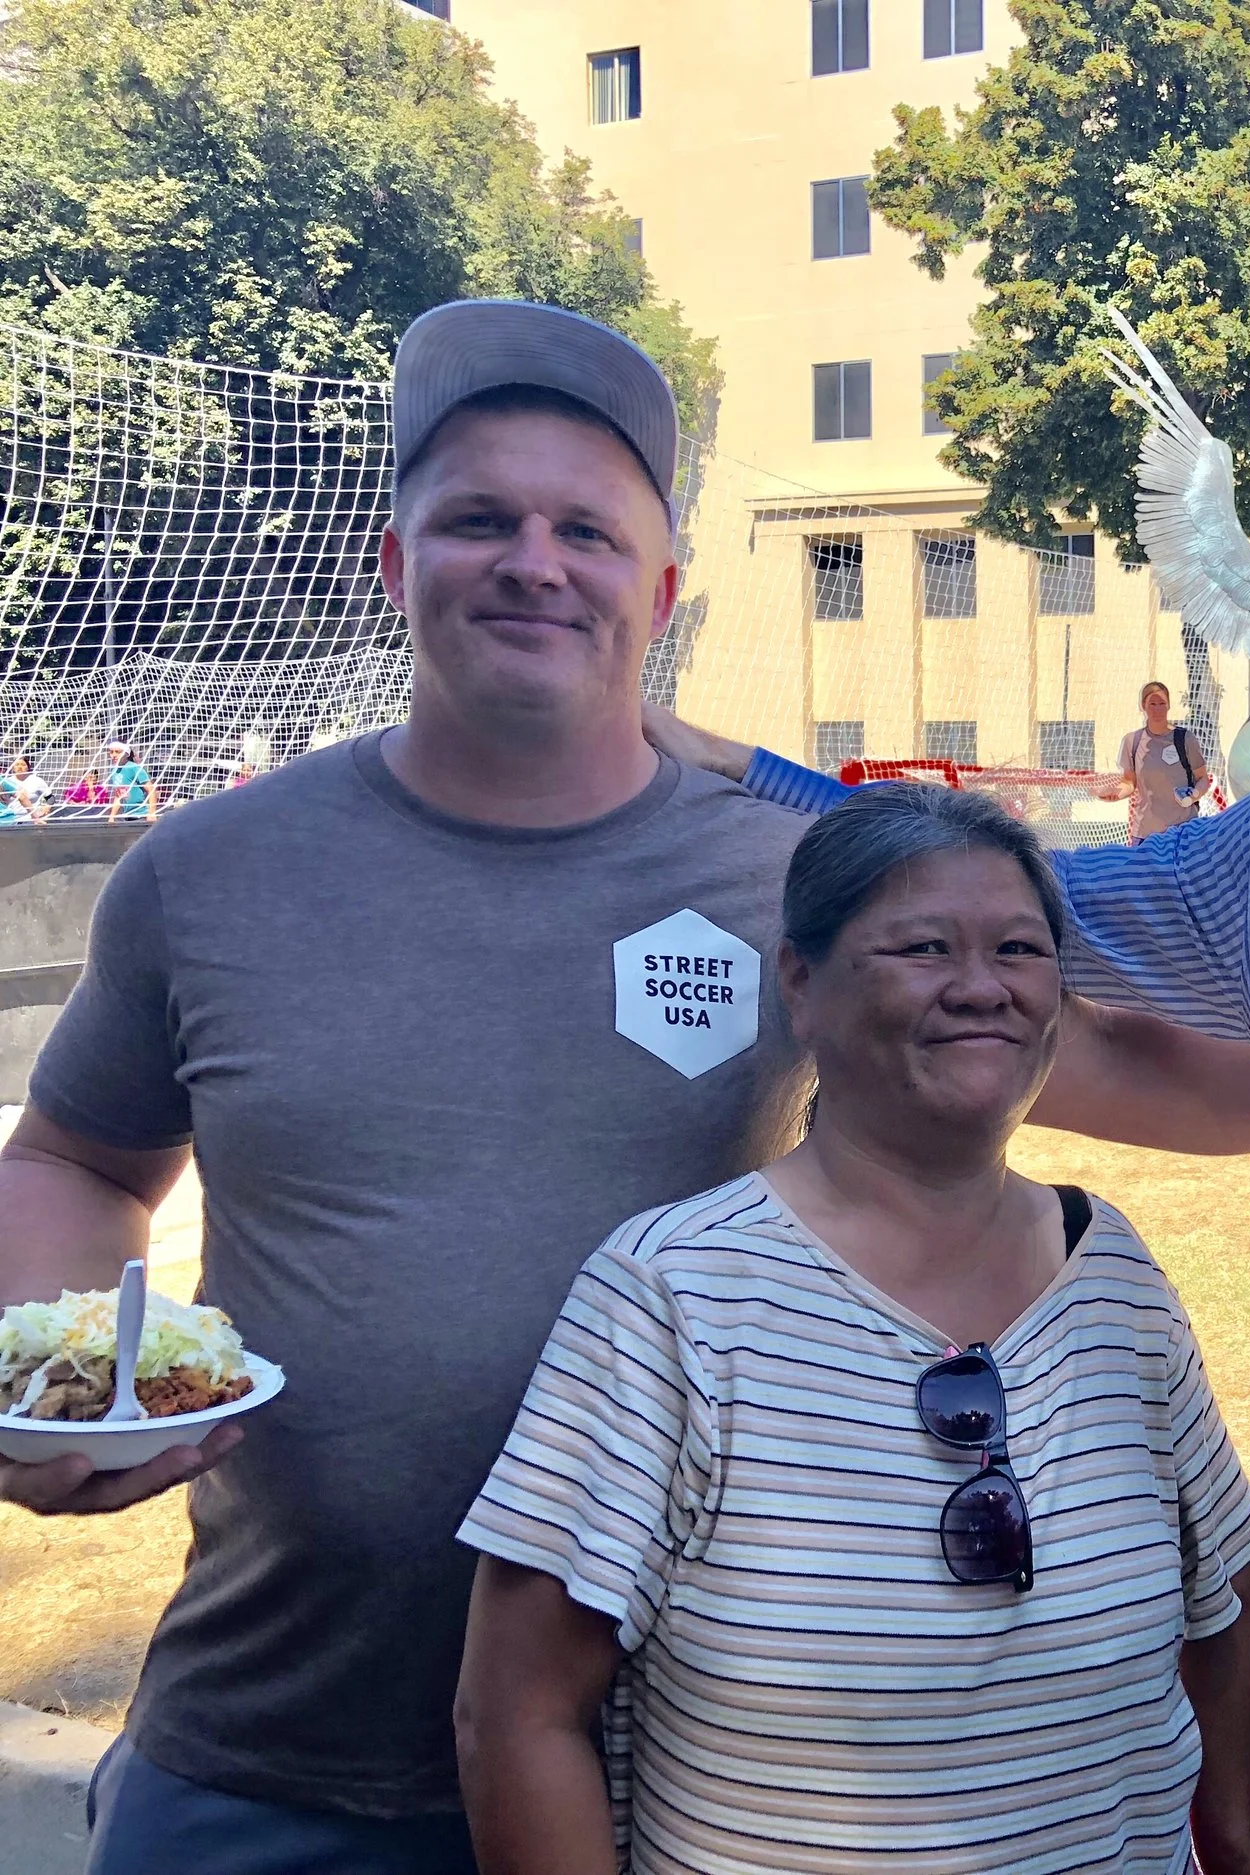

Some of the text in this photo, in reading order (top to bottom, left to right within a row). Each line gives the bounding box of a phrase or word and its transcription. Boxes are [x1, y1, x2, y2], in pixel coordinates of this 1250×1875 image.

[644, 954, 734, 979] STREET
[645, 978, 734, 1005] SOCCER
[664, 1006, 712, 1029] USA
